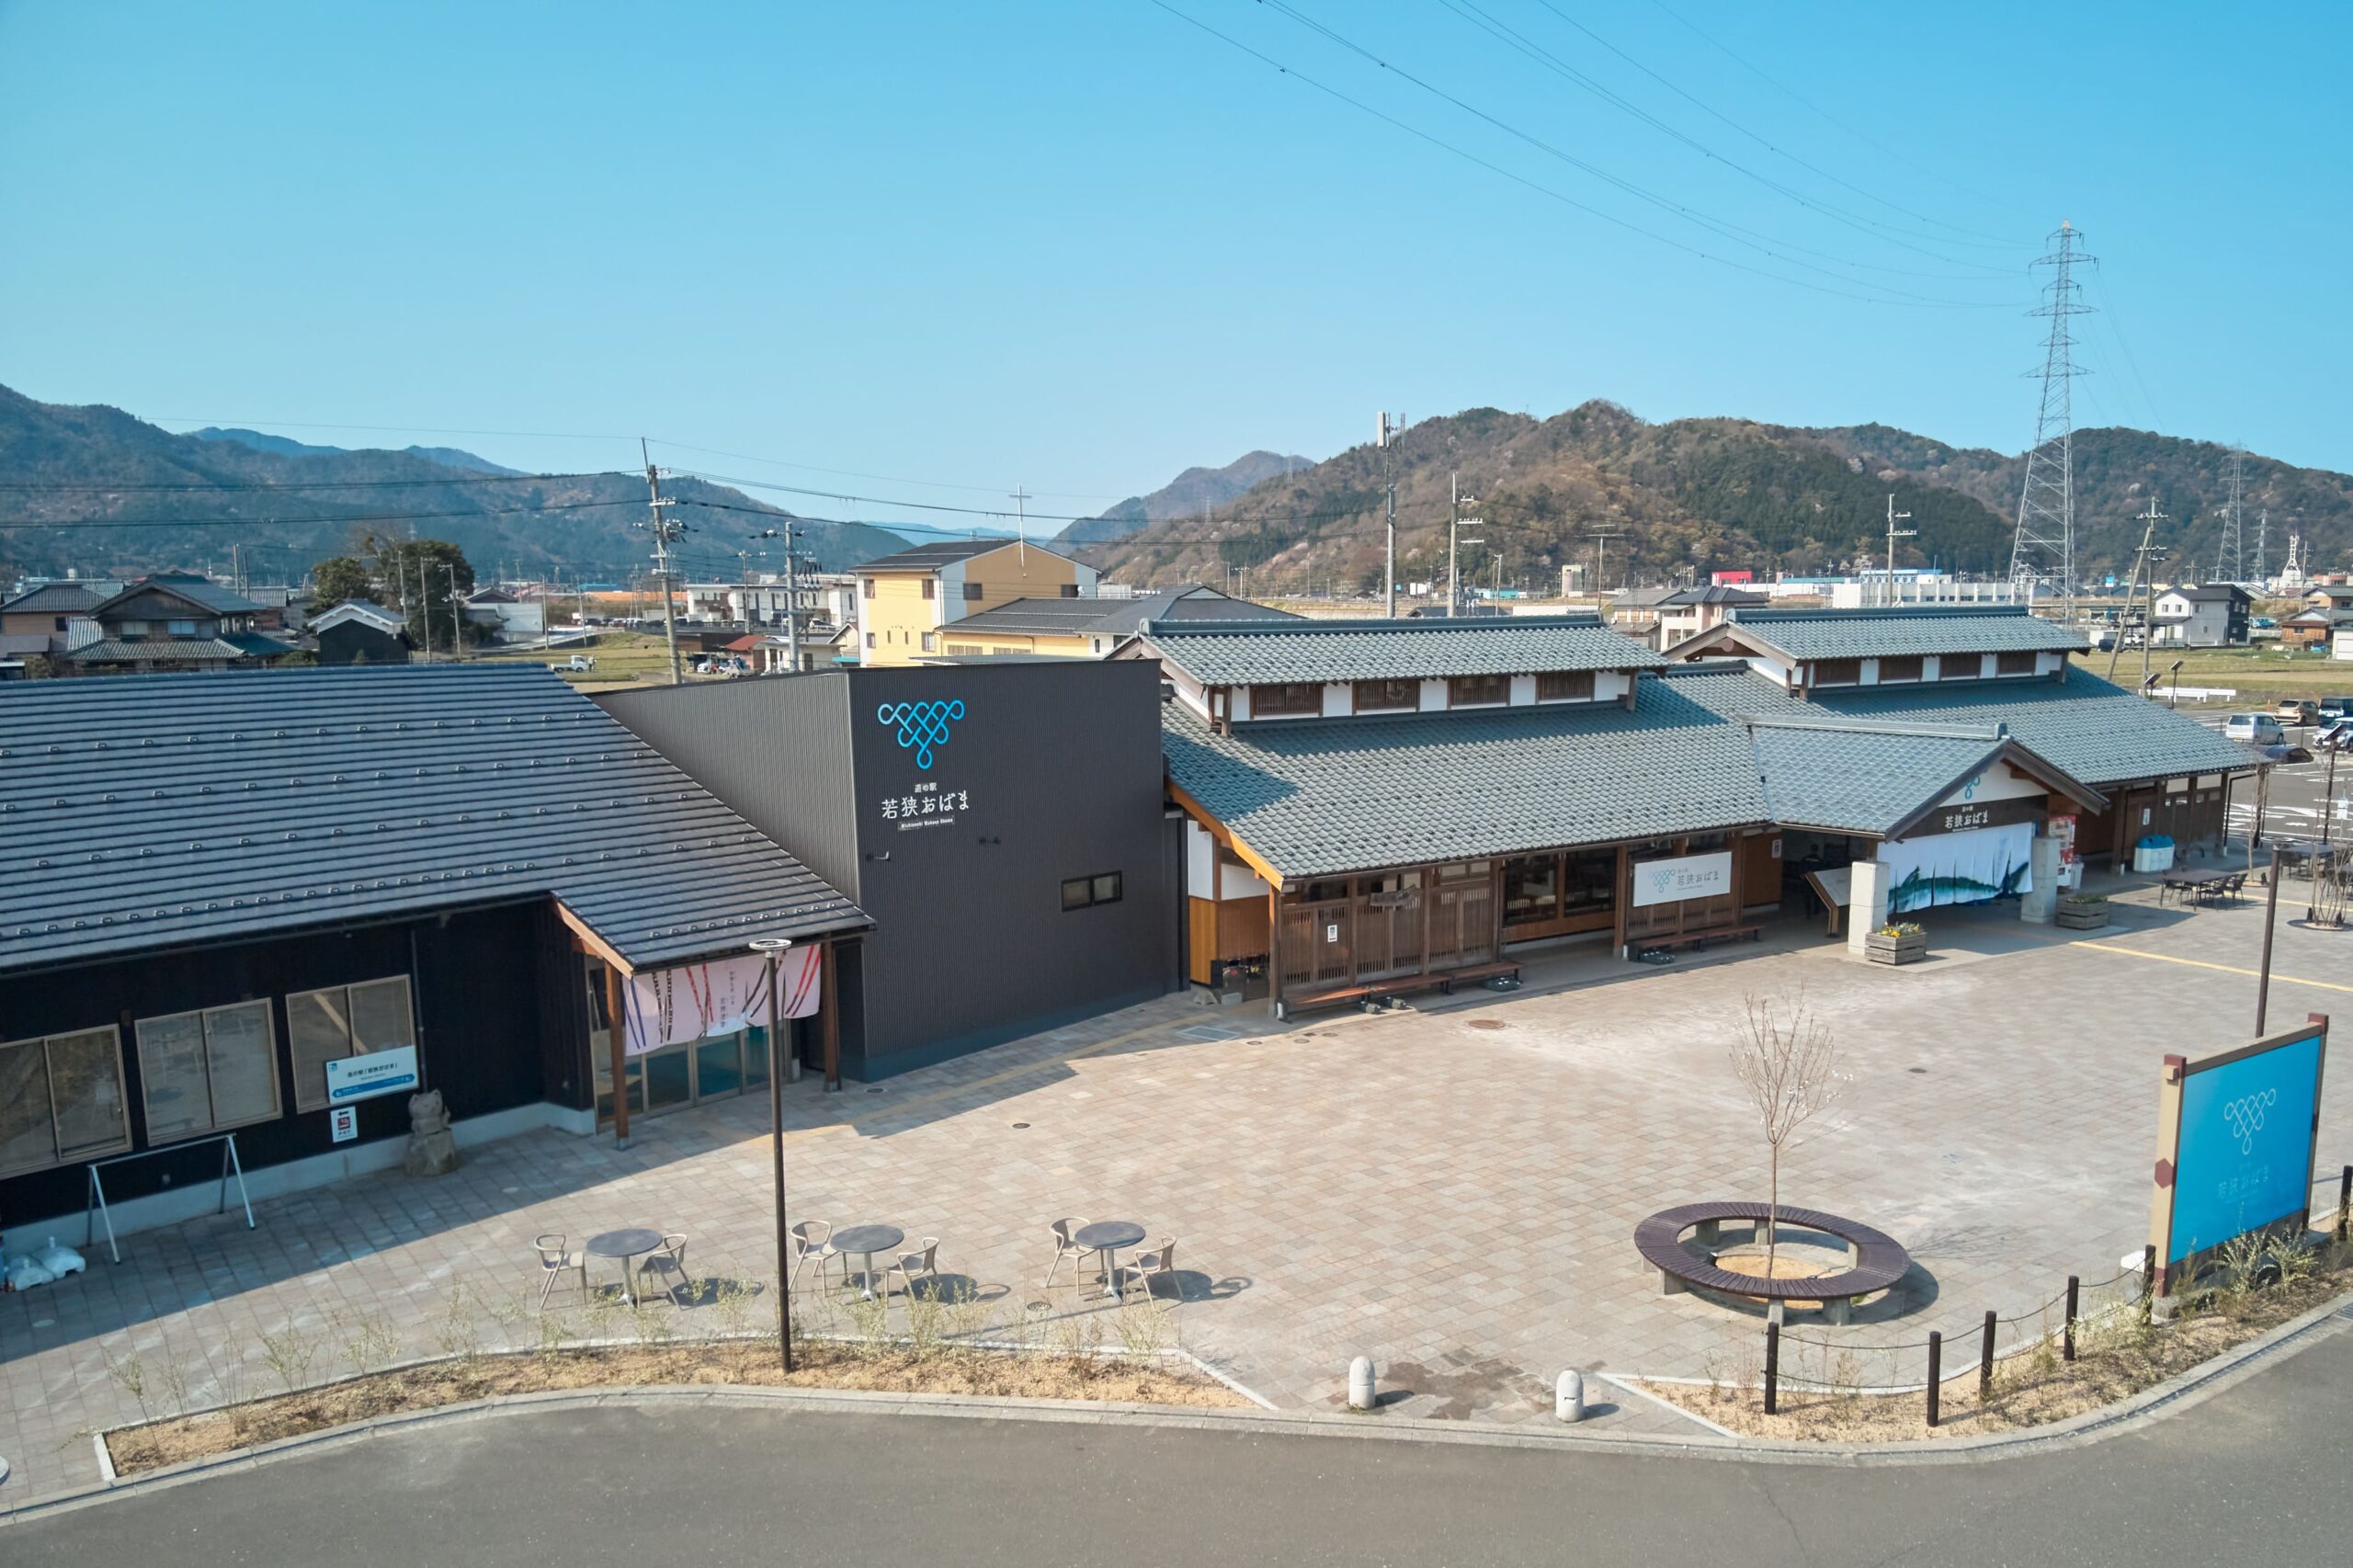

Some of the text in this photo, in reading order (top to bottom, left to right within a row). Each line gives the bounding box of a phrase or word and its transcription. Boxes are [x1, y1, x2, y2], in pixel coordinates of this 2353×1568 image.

[881, 790, 970, 819] 若狭おばま
